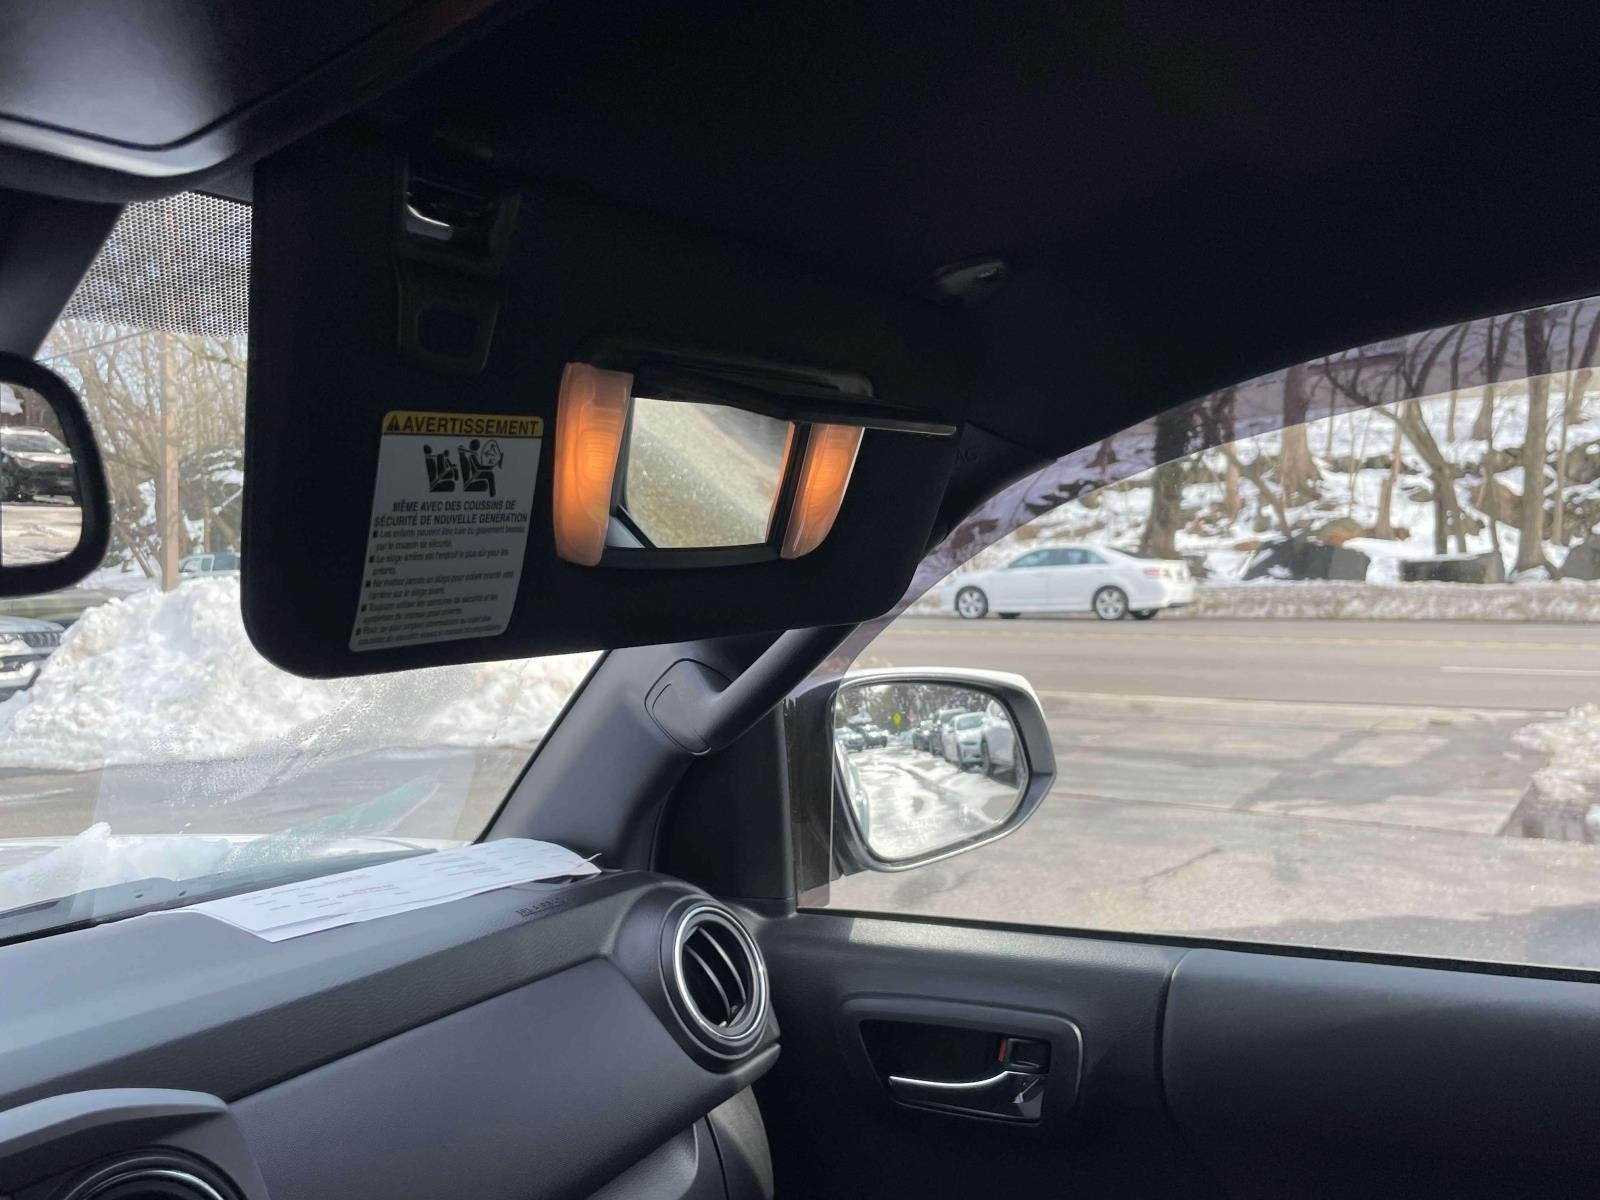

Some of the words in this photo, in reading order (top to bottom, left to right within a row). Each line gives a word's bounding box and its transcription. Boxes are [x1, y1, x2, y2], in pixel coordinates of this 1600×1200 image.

[402, 415, 539, 435] AVERTISSEMENT
[392, 498, 417, 512] MÊME
[420, 500, 443, 512] AVEC
[446, 500, 461, 511] DES
[463, 500, 504, 511] COUSSINS
[505, 499, 517, 510] DE
[374, 512, 418, 527] SÉCURITÉ
[420, 514, 433, 526] DE
[434, 513, 477, 525] NOUVELLE
[479, 511, 529, 524] GÉNÉRATION
